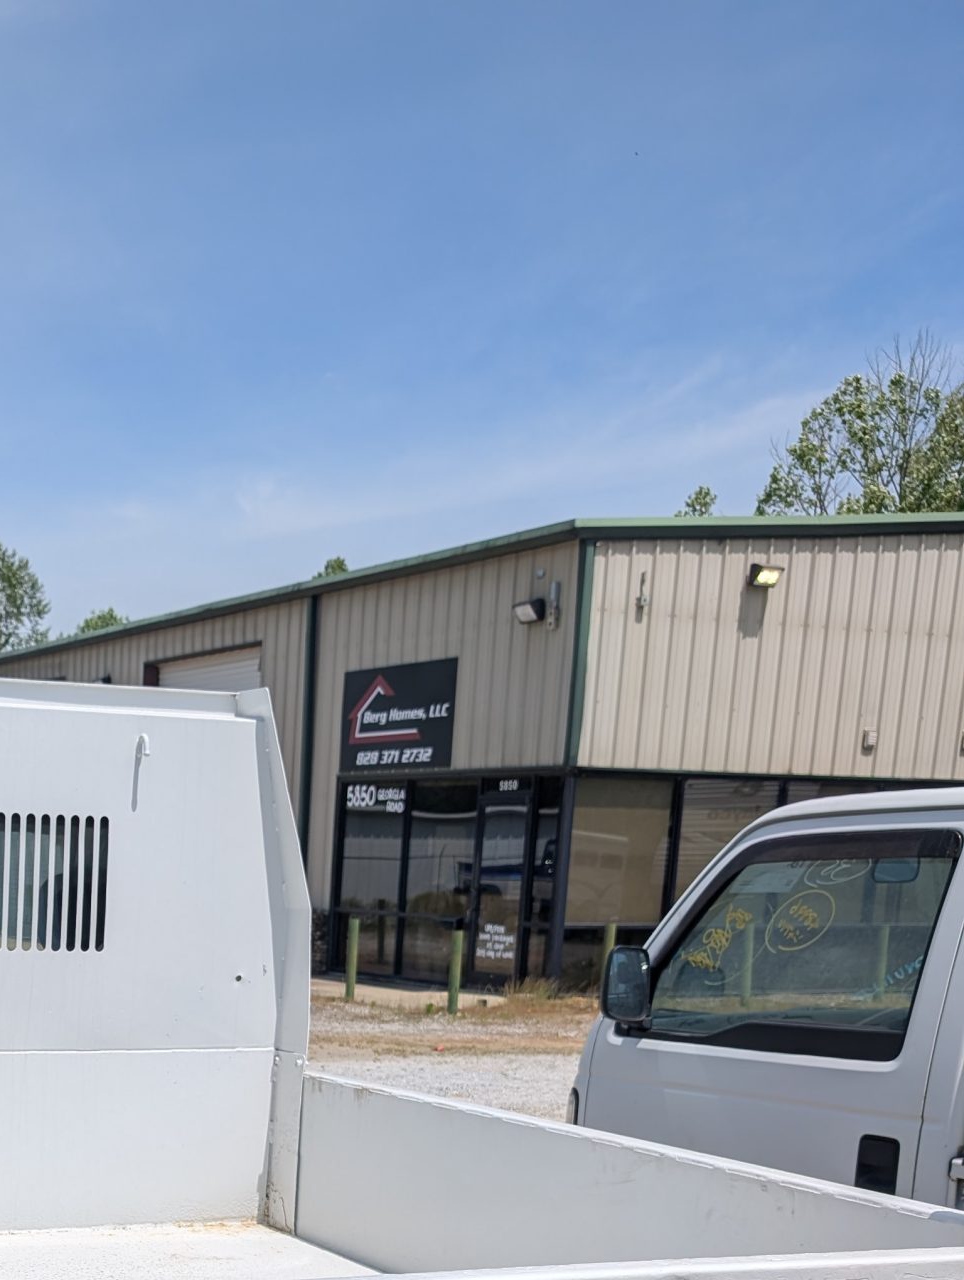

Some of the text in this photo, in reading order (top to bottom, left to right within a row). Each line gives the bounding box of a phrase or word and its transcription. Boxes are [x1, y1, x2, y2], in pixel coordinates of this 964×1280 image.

[363, 709, 387, 726] Berg
[429, 702, 451, 718] LLC
[380, 748, 400, 764] 371
[401, 747, 434, 763] 2732
[346, 784, 406, 807] 5850 GEORGIA
[385, 800, 405, 813] ROAD
